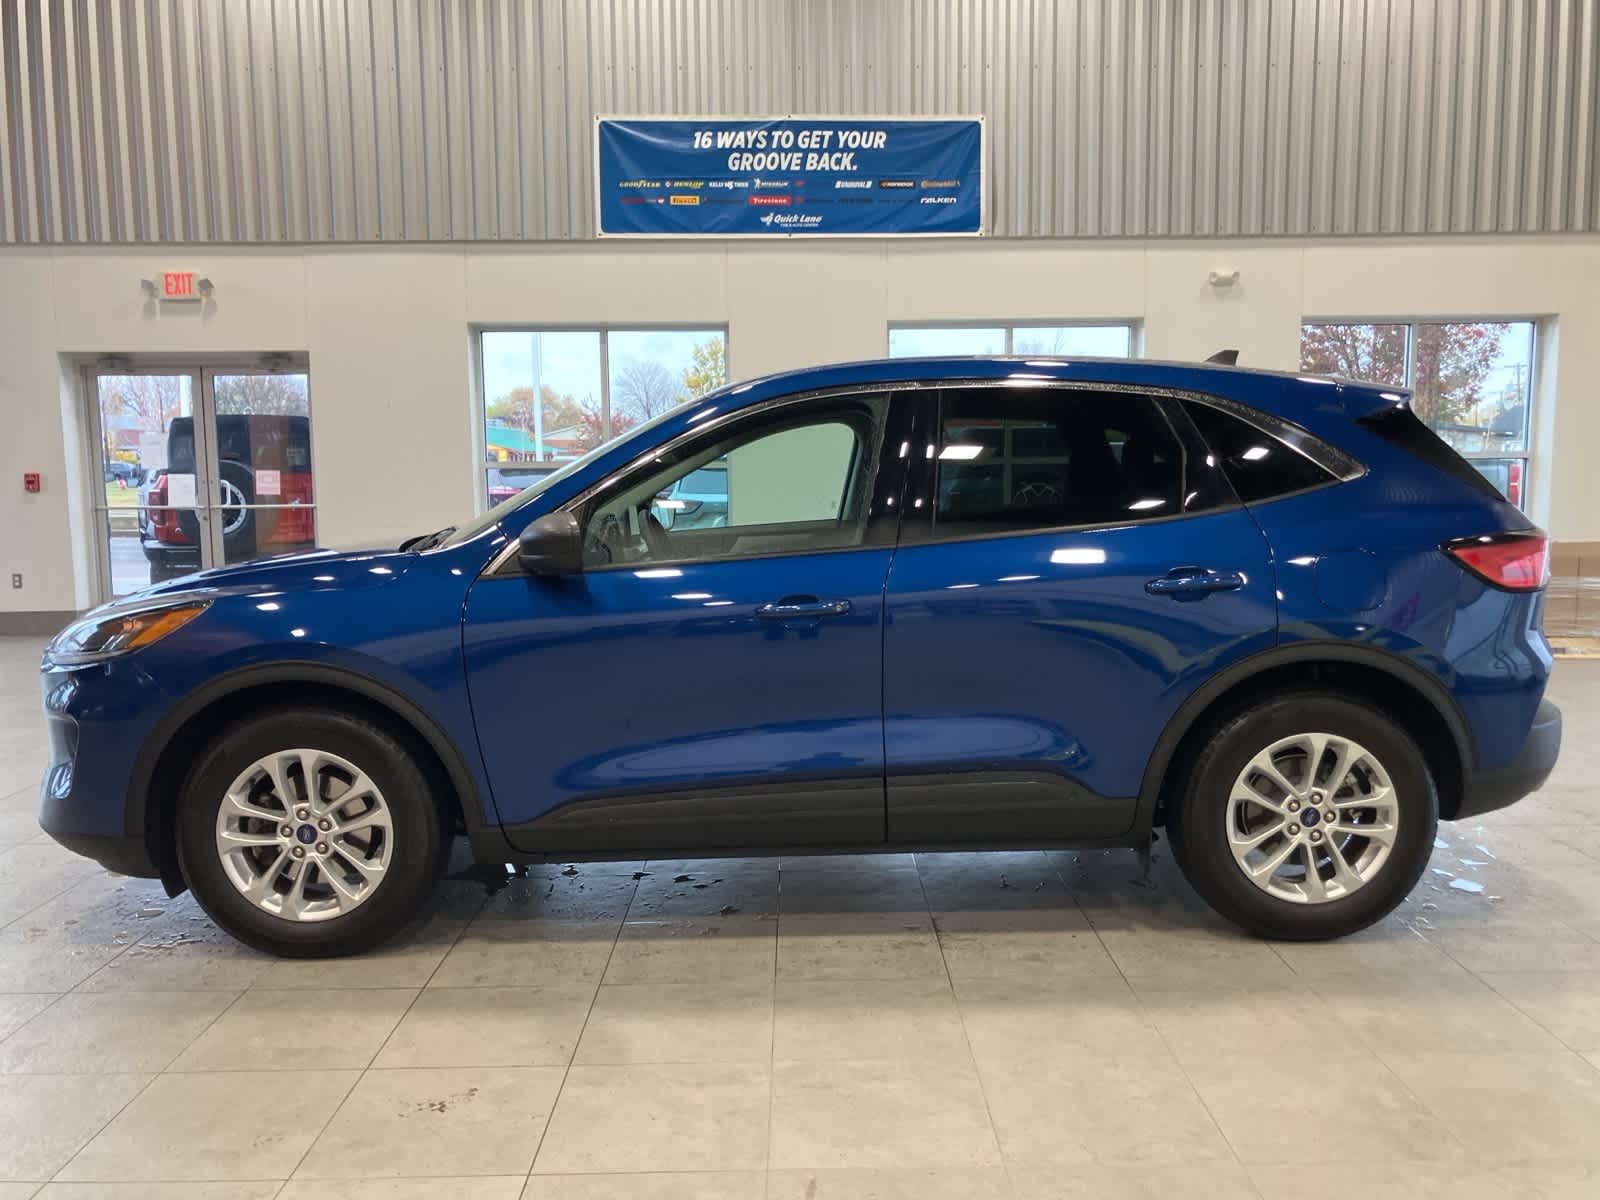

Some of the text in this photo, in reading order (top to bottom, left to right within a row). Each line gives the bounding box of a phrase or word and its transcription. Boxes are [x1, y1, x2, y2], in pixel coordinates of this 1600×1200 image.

[694, 130, 886, 149] 16 WAYS TO GET YOUR
[728, 152, 858, 171] GROOVE BACK.
[774, 214, 824, 224] Quick Lane
[163, 271, 193, 297] EXIT
